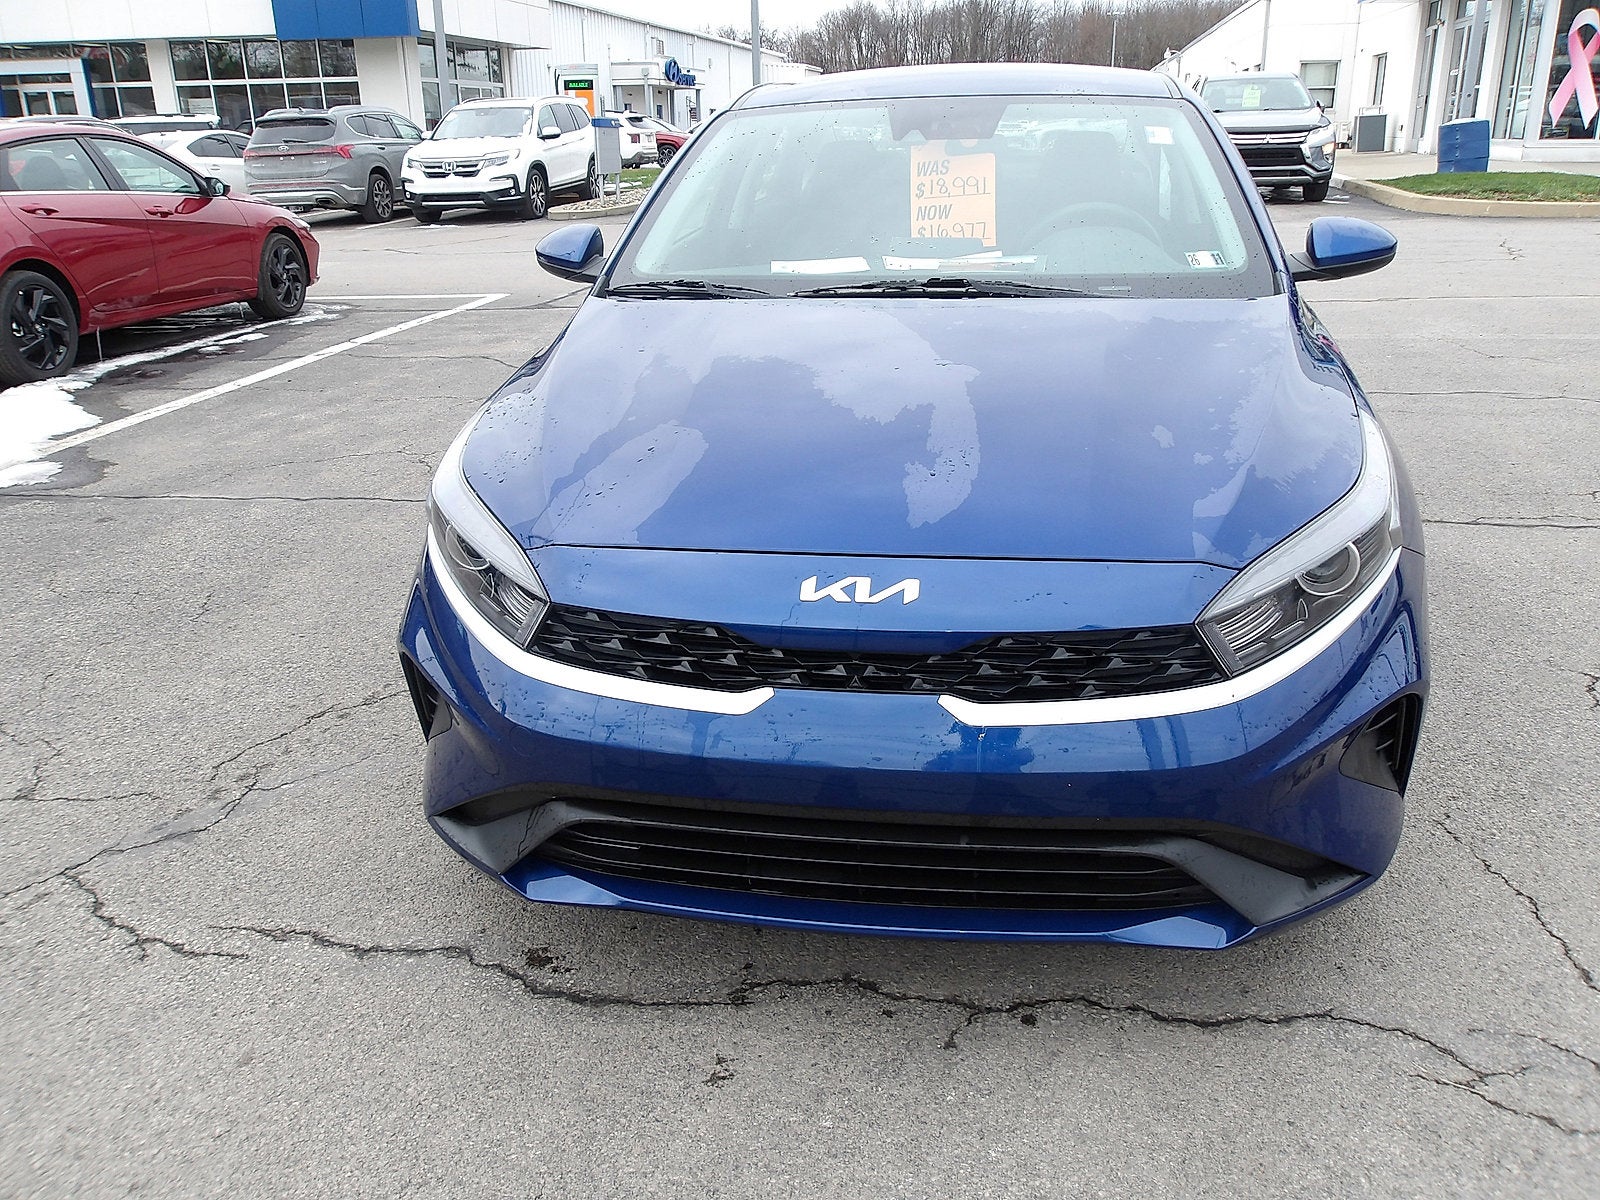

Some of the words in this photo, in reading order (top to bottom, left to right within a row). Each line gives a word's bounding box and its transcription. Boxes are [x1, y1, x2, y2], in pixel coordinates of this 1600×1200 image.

[916, 160, 950, 177] WAS
[915, 176, 986, 199] $18,991
[916, 204, 953, 221] NOW
[1188, 254, 1200, 265] 26
